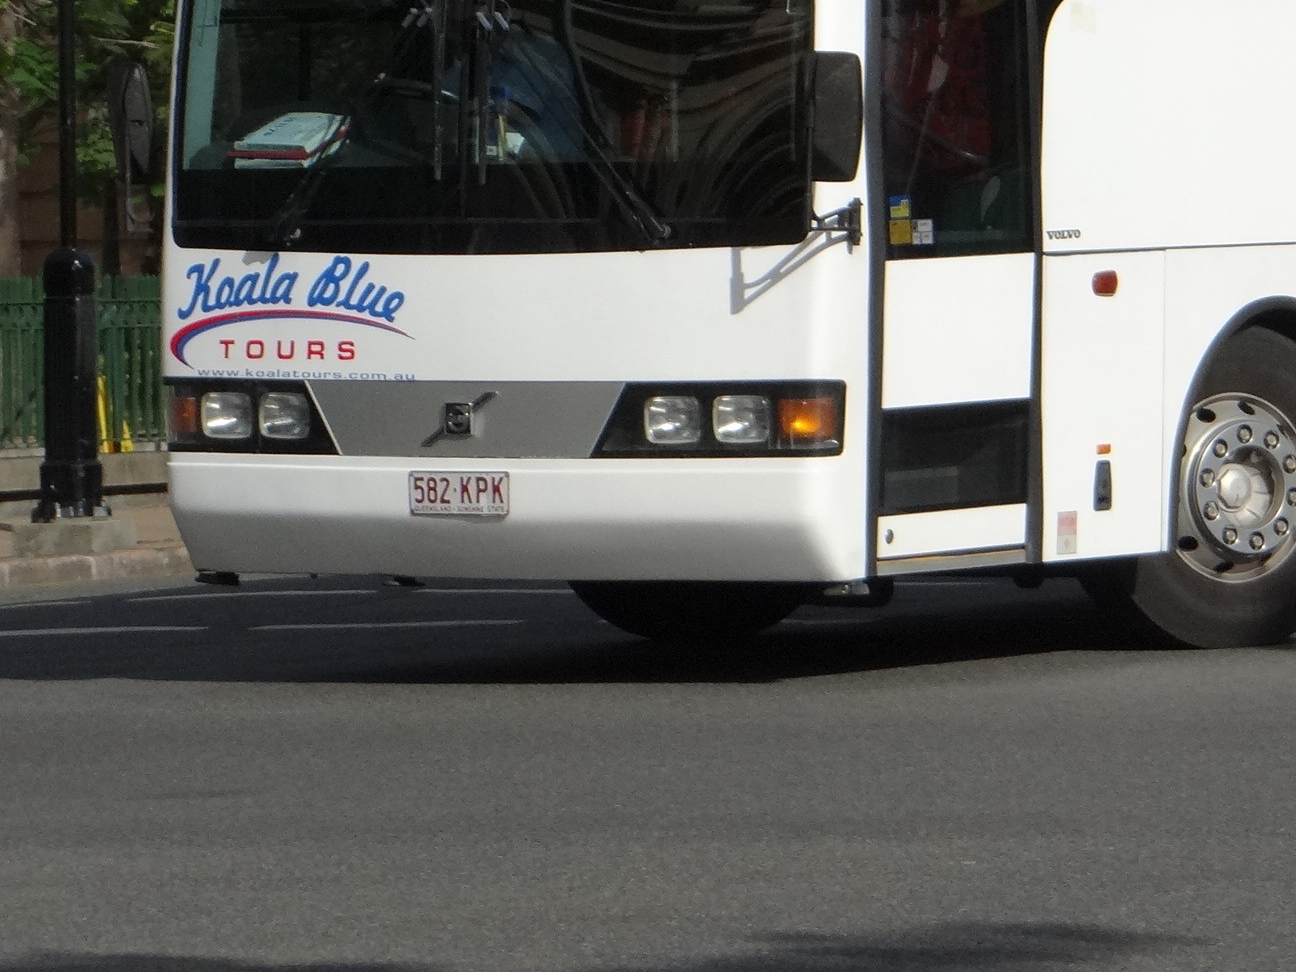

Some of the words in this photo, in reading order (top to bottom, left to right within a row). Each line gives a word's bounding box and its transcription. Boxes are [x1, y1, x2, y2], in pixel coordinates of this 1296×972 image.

[1046, 229, 1081, 240] VOLVO
[177, 251, 300, 320] Koala
[306, 255, 406, 324] Blue
[219, 339, 356, 361] TOURS
[197, 367, 416, 382] www.koalatours.com.au
